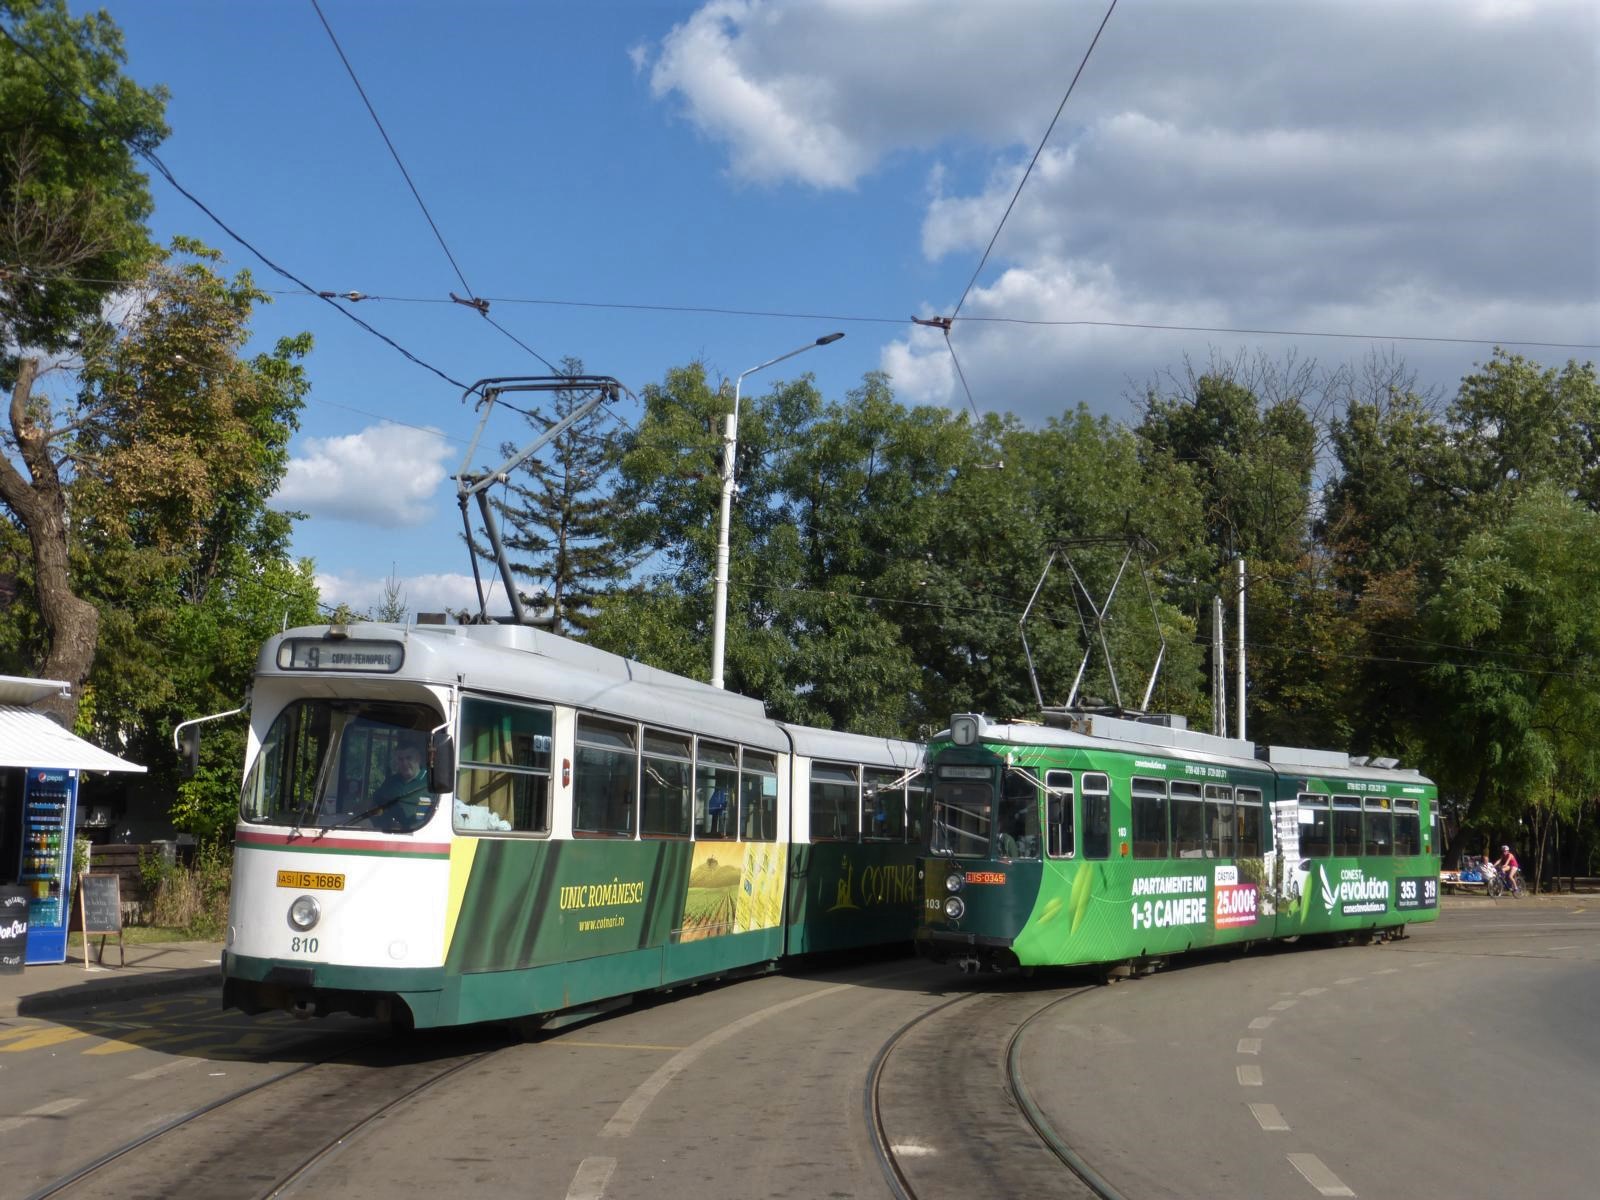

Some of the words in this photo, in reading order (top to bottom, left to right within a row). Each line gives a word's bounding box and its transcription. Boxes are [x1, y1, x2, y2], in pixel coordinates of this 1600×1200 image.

[961, 724, 970, 743] 1
[299, 874, 342, 888] IS-1686
[1341, 869, 1362, 880] CONEST
[560, 885, 587, 910] UNIC
[587, 876, 644, 907] ROMÂNESC!
[1131, 876, 1193, 896] APARTAMENTE
[1193, 875, 1207, 893] NOI
[1340, 875, 1389, 900] evolution
[1400, 880, 1417, 899] 353
[926, 899, 940, 910] 103
[1216, 888, 1257, 914] 25.000€
[579, 914, 625, 932] www.cotnari.ro
[1131, 901, 1153, 930] 1-3
[1154, 898, 1207, 928] CAMERE
[291, 936, 319, 953] 810
